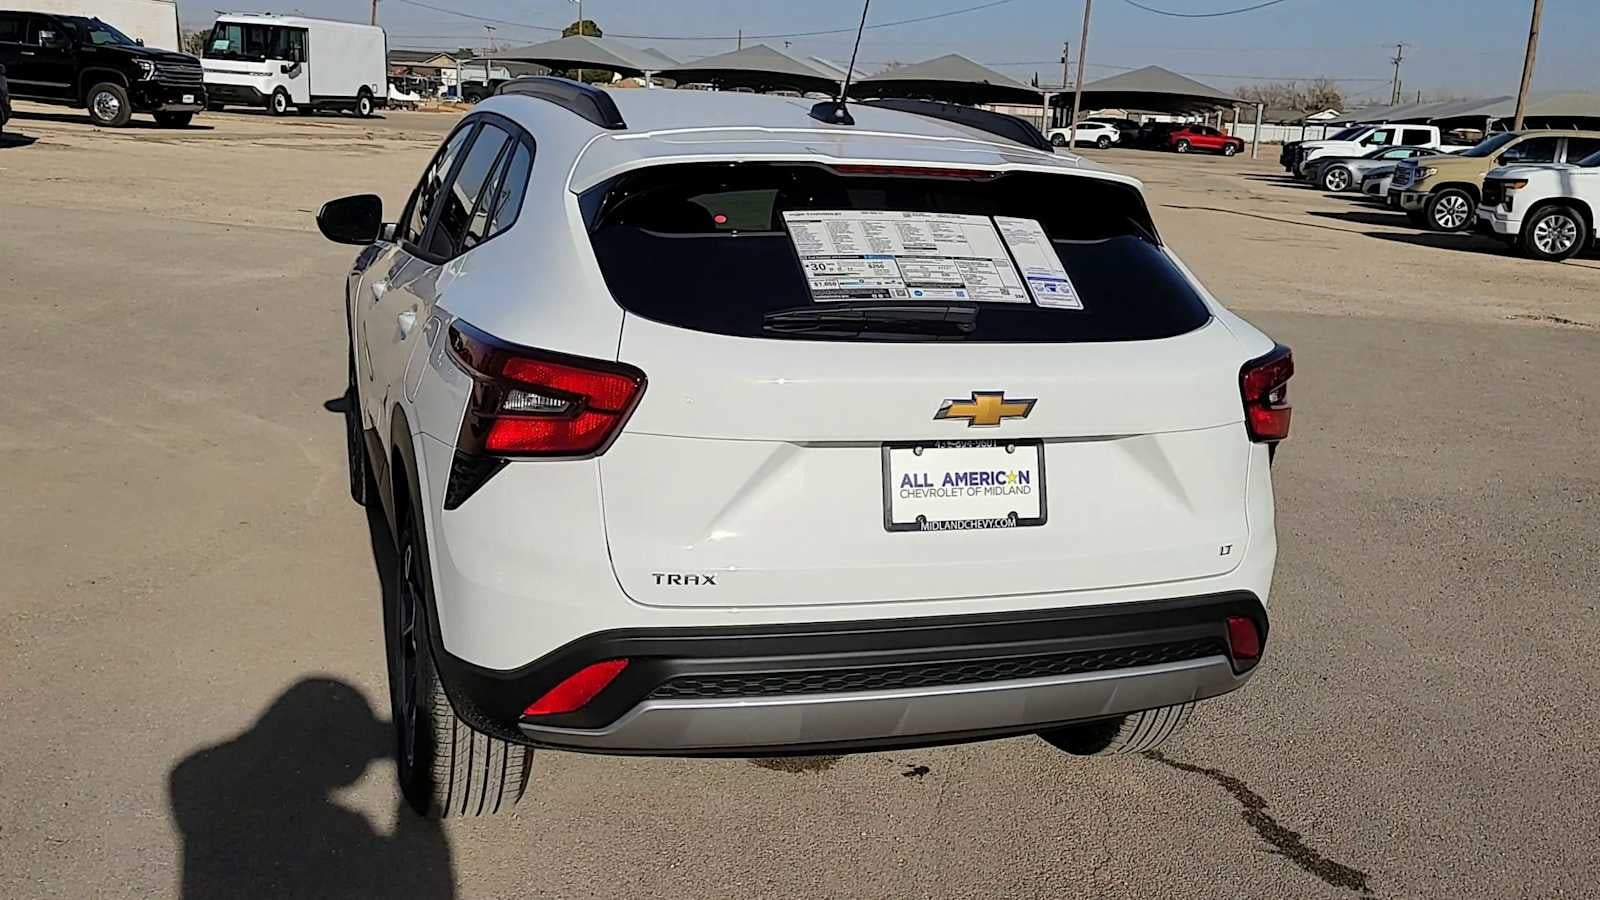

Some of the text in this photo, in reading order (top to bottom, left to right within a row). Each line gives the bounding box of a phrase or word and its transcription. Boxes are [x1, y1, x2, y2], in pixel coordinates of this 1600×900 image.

[811, 263, 826, 271] 30
[900, 473, 934, 488] ALL
[900, 485, 1031, 499] CHEVROLET OF MIDLAND
[920, 518, 1017, 531] MIDLANDCHEVY.COM
[1219, 544, 1233, 556] LT
[651, 573, 717, 586] TRAX
